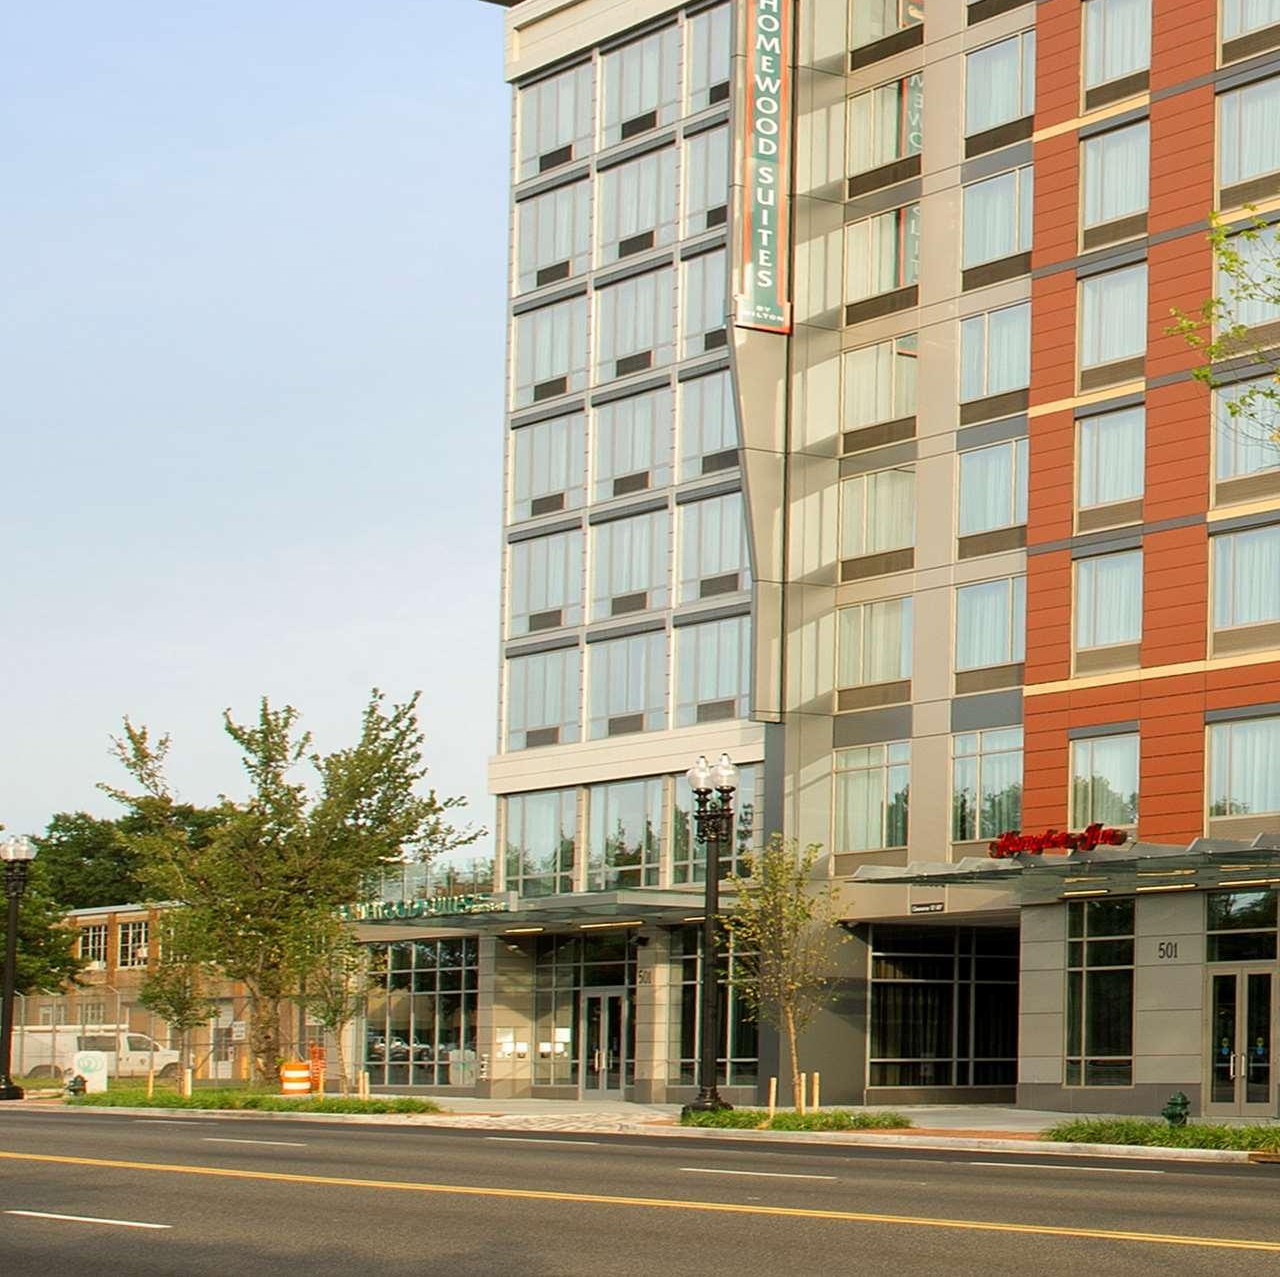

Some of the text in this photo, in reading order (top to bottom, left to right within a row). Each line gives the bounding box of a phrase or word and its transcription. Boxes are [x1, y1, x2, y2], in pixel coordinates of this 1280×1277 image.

[757, 166, 775, 288] SUITES
[755, 305, 771, 313] BY
[1158, 942, 1178, 959] 501
